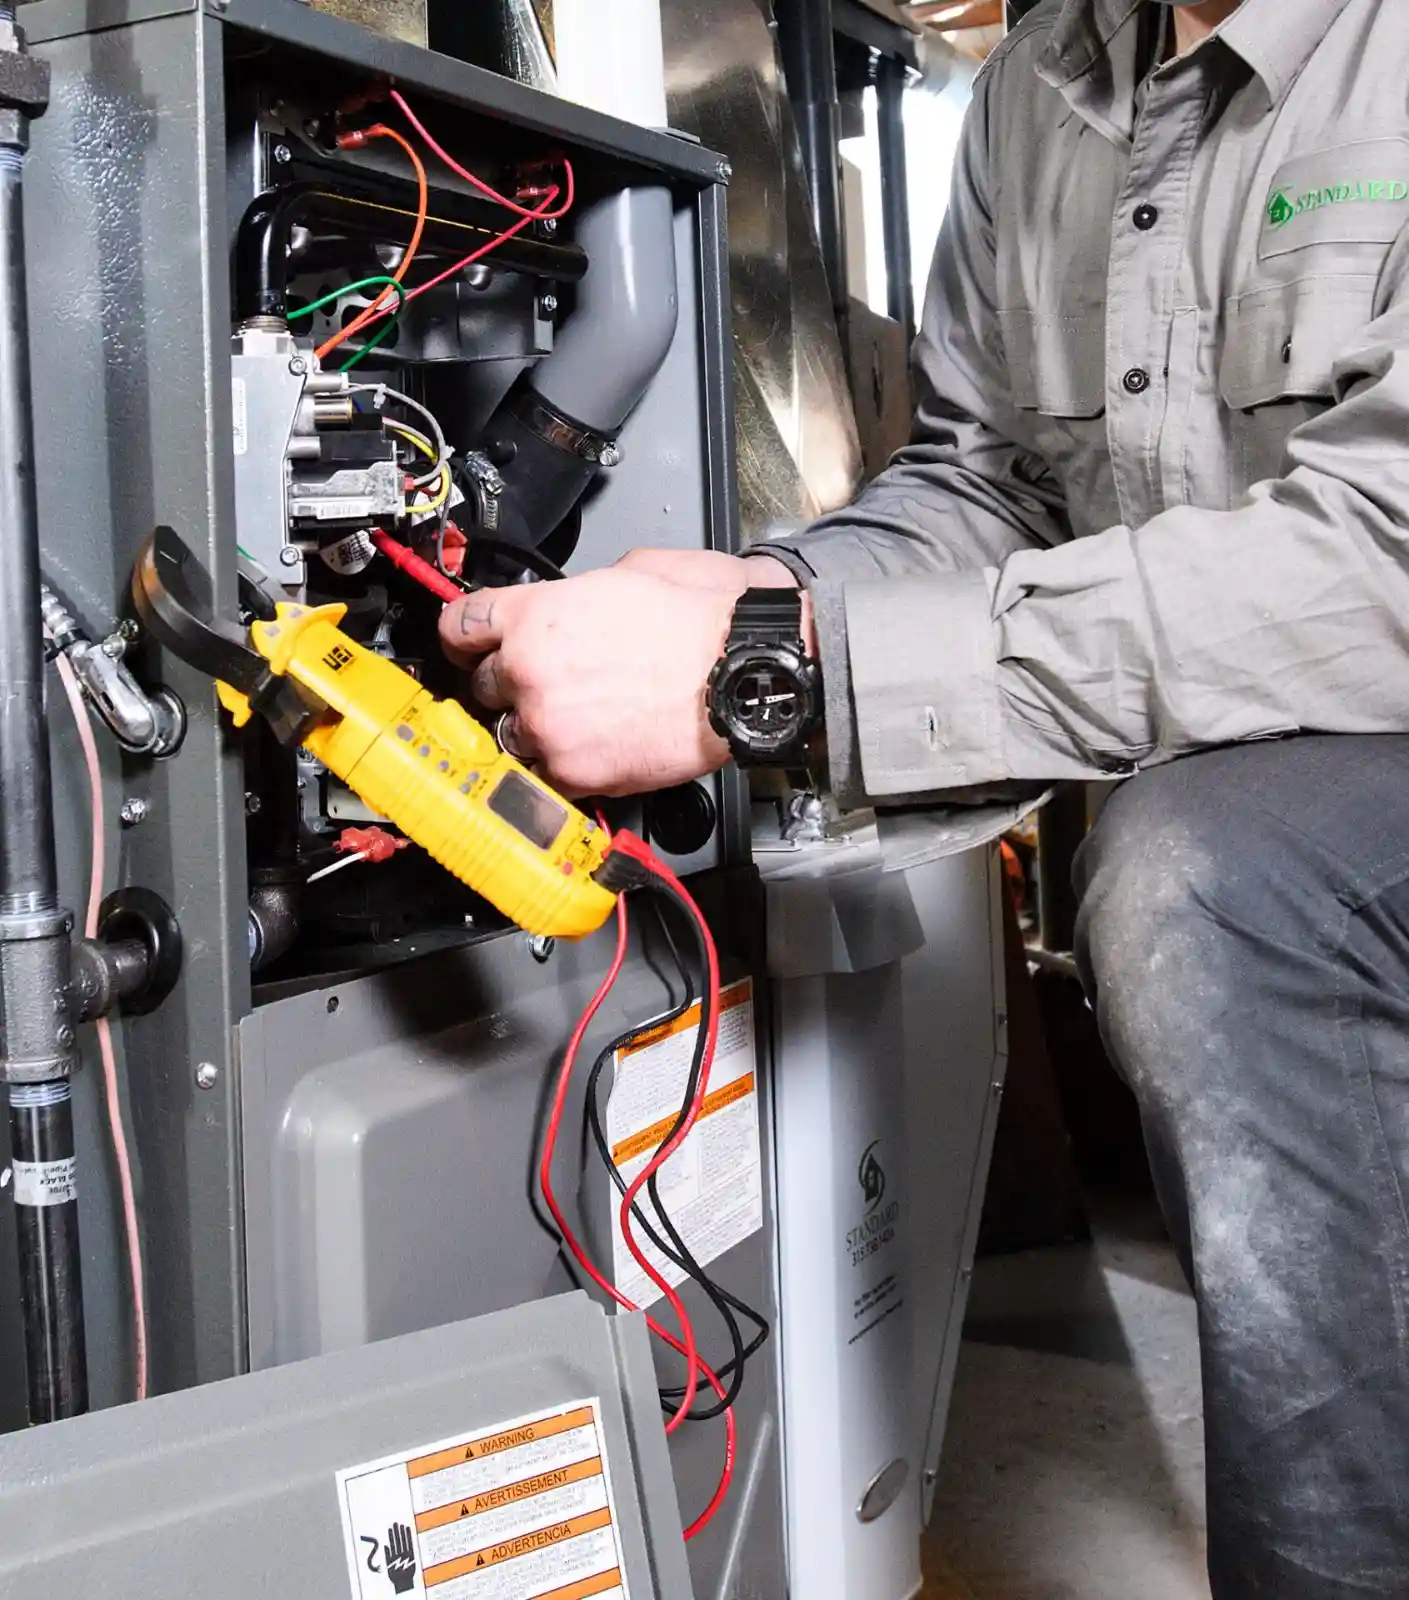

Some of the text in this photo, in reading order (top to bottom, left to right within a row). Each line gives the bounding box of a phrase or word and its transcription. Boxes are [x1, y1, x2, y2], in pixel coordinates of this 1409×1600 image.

[1296, 180, 1408, 213] STANDARD
[845, 1201, 899, 1252] STANDARD
[479, 1428, 535, 1454] WARNING
[474, 1470, 569, 1510] AVERTISSEMENT
[491, 1524, 572, 1560] ADVERTENCIA
